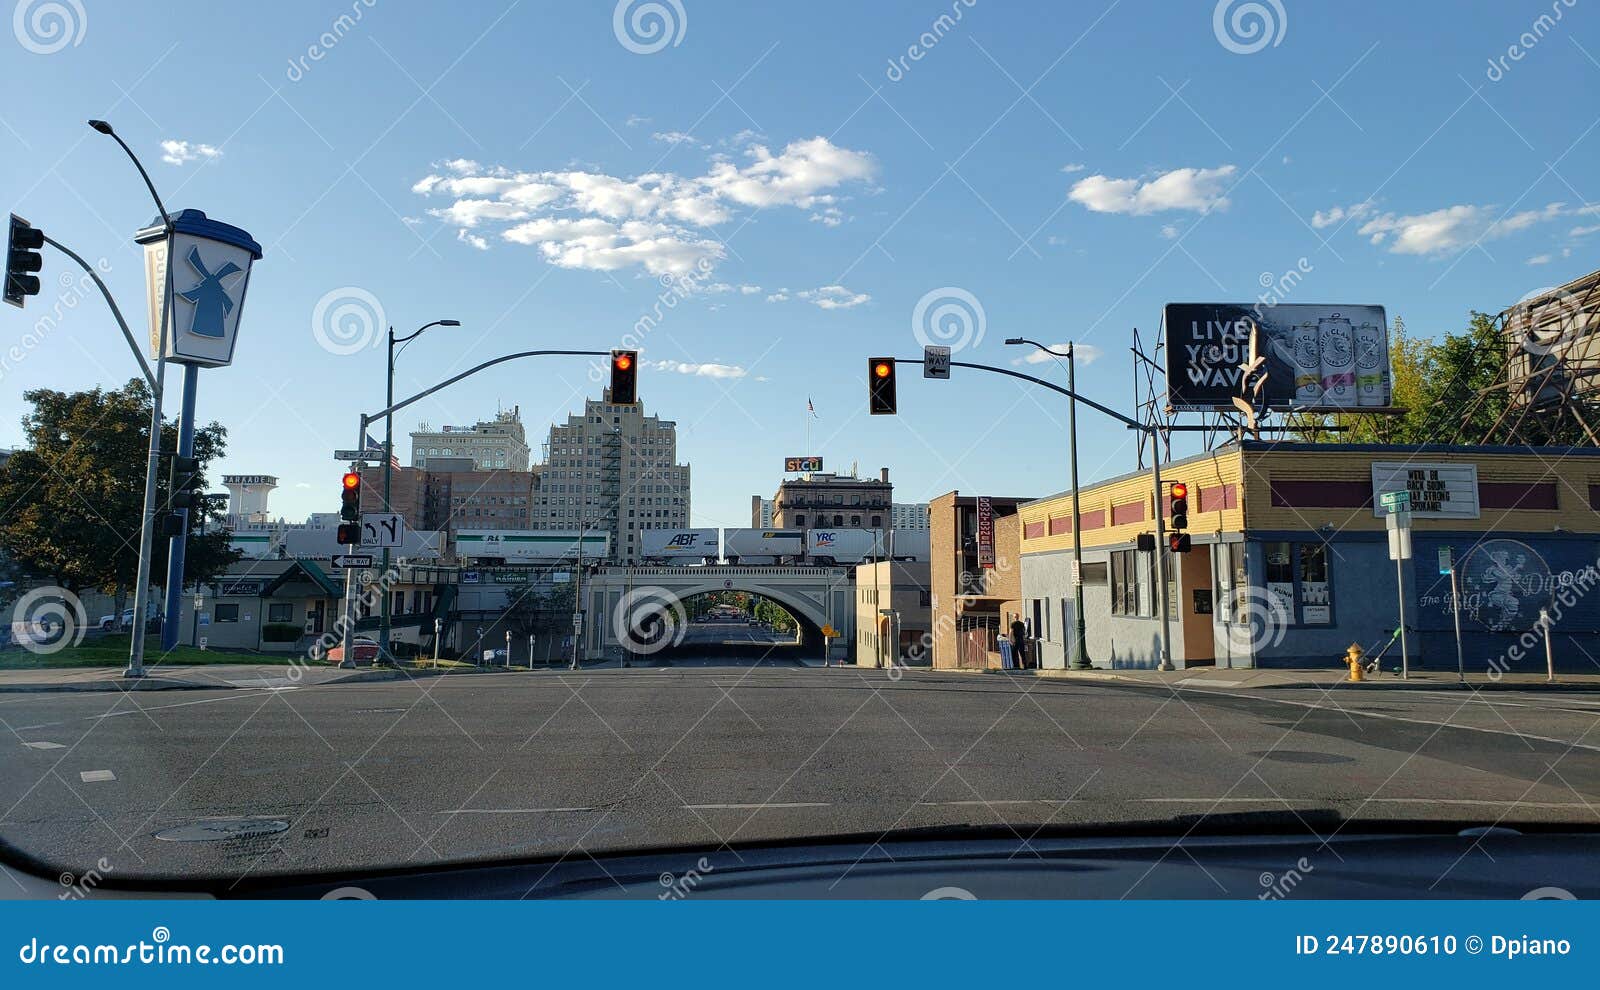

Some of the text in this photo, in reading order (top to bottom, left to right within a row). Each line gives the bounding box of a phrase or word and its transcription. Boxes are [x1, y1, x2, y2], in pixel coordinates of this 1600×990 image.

[1192, 321, 1249, 339] LIVE
[928, 348, 947, 357] ONE
[928, 357, 947, 365] WAY
[223, 475, 266, 484] PARKADE
[1406, 480, 1424, 491] BACK
[1423, 490, 1450, 502] STRONG
[667, 533, 700, 546] ABF
[815, 532, 837, 541] YRC
